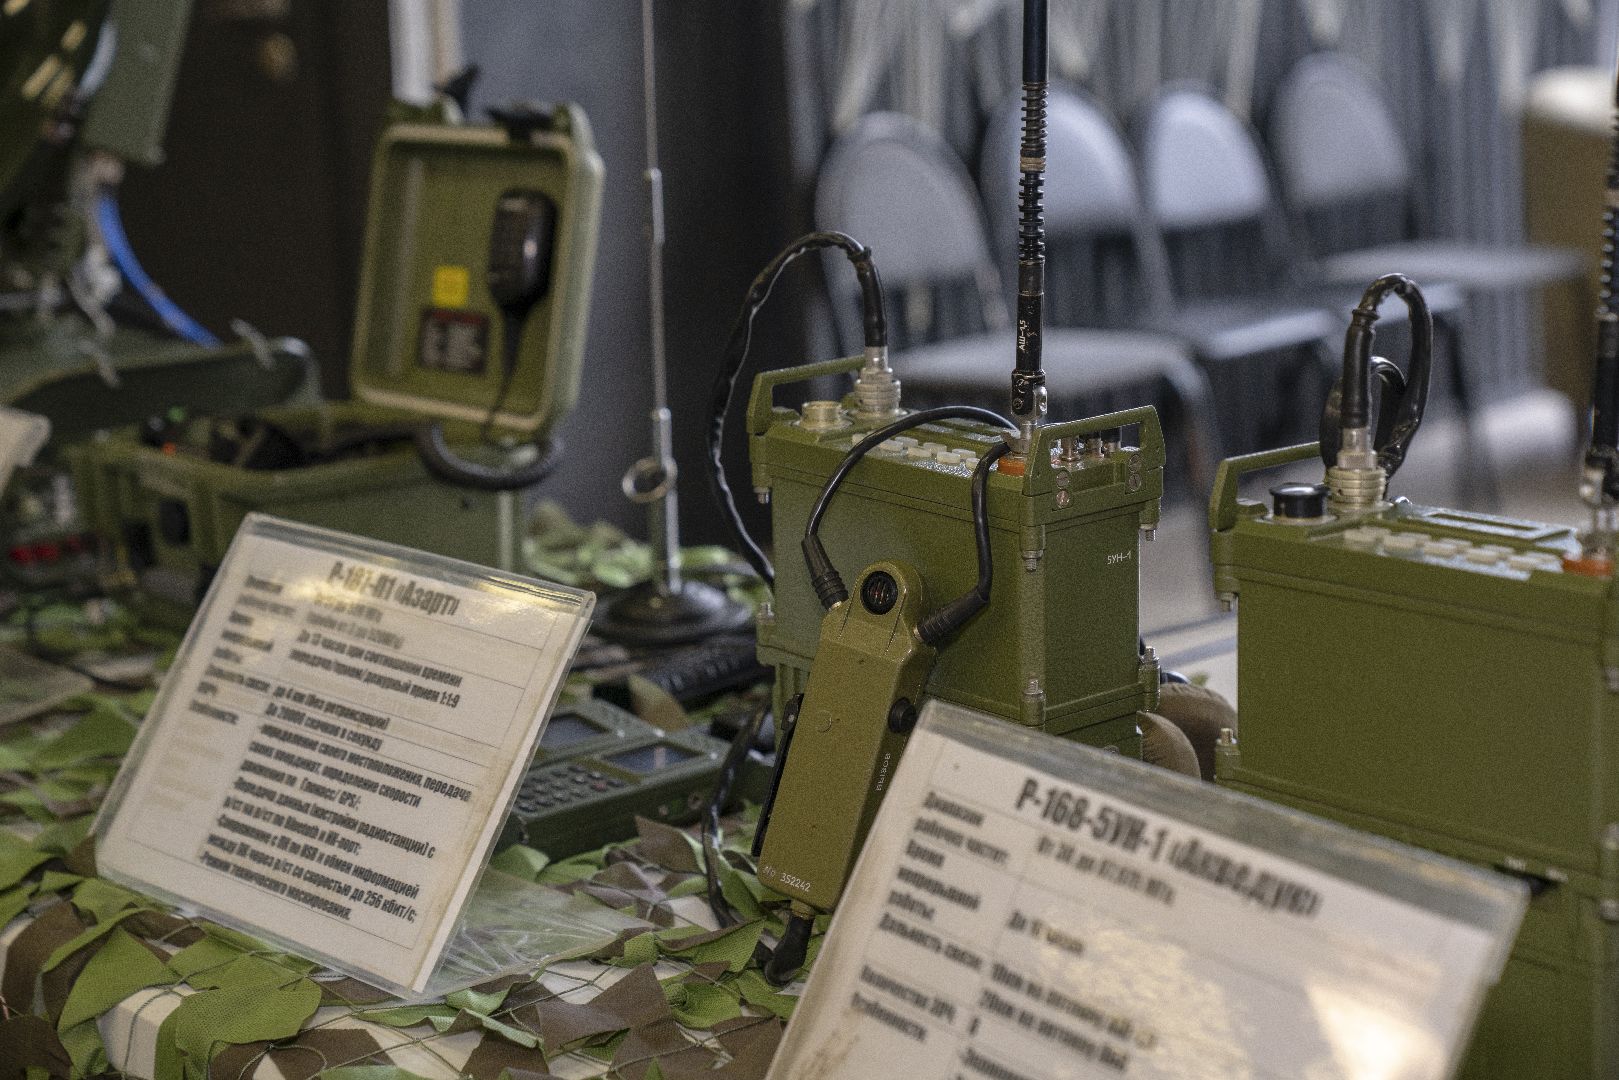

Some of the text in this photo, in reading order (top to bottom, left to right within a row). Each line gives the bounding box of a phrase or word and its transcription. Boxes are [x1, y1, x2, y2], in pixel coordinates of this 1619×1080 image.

[1107, 550, 1131, 565] 5УН-1
[392, 582, 460, 617] «Азарт»
[422, 665, 462, 687] времени
[440, 690, 460, 707] 1:1:9
[379, 783, 421, 807] скорости
[423, 776, 472, 803] передача
[1016, 777, 1168, 862] Р-168-5УН-1
[352, 861, 420, 900] информацией
[780, 872, 811, 892] 352242
[364, 889, 383, 908] 256
[381, 896, 419, 923] кбит/с;
